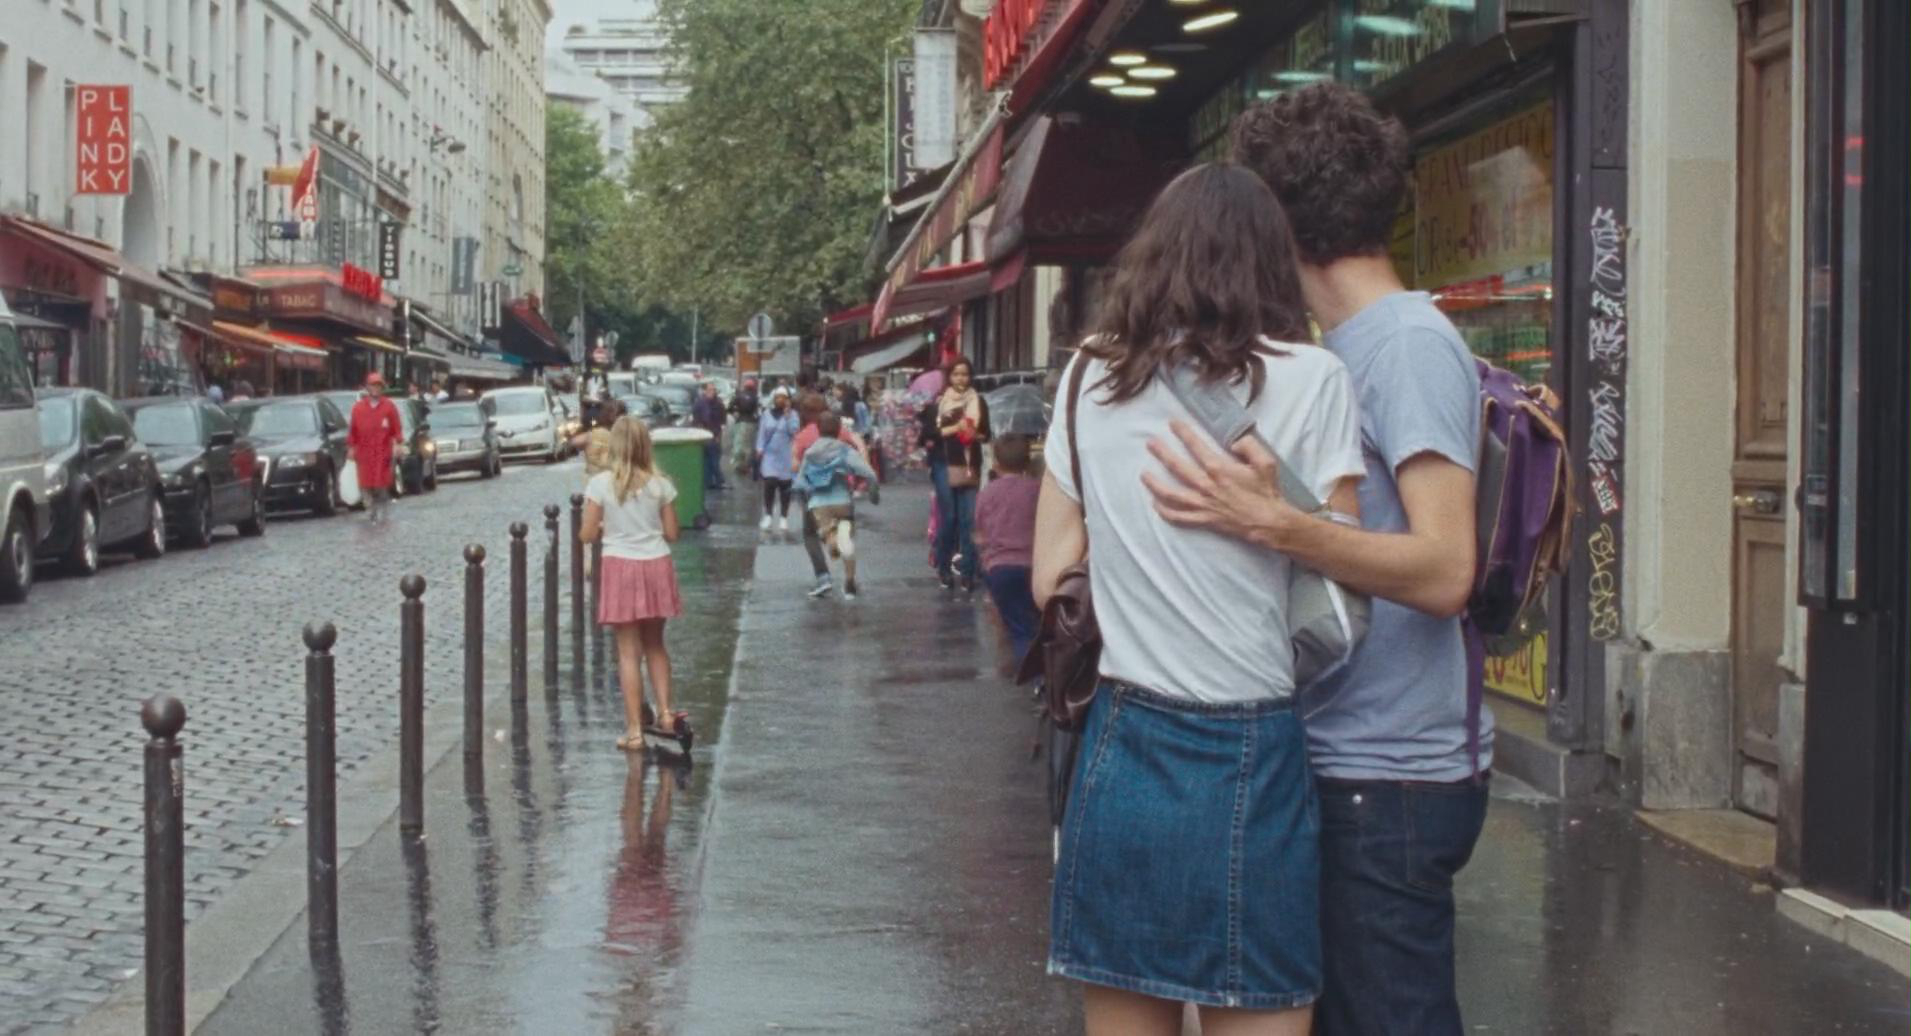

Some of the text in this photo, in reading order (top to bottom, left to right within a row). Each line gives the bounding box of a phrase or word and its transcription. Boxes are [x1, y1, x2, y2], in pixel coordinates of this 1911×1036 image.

[81, 89, 99, 191] PINK
[107, 89, 126, 191] LADY
[281, 295, 316, 308] TABAC
